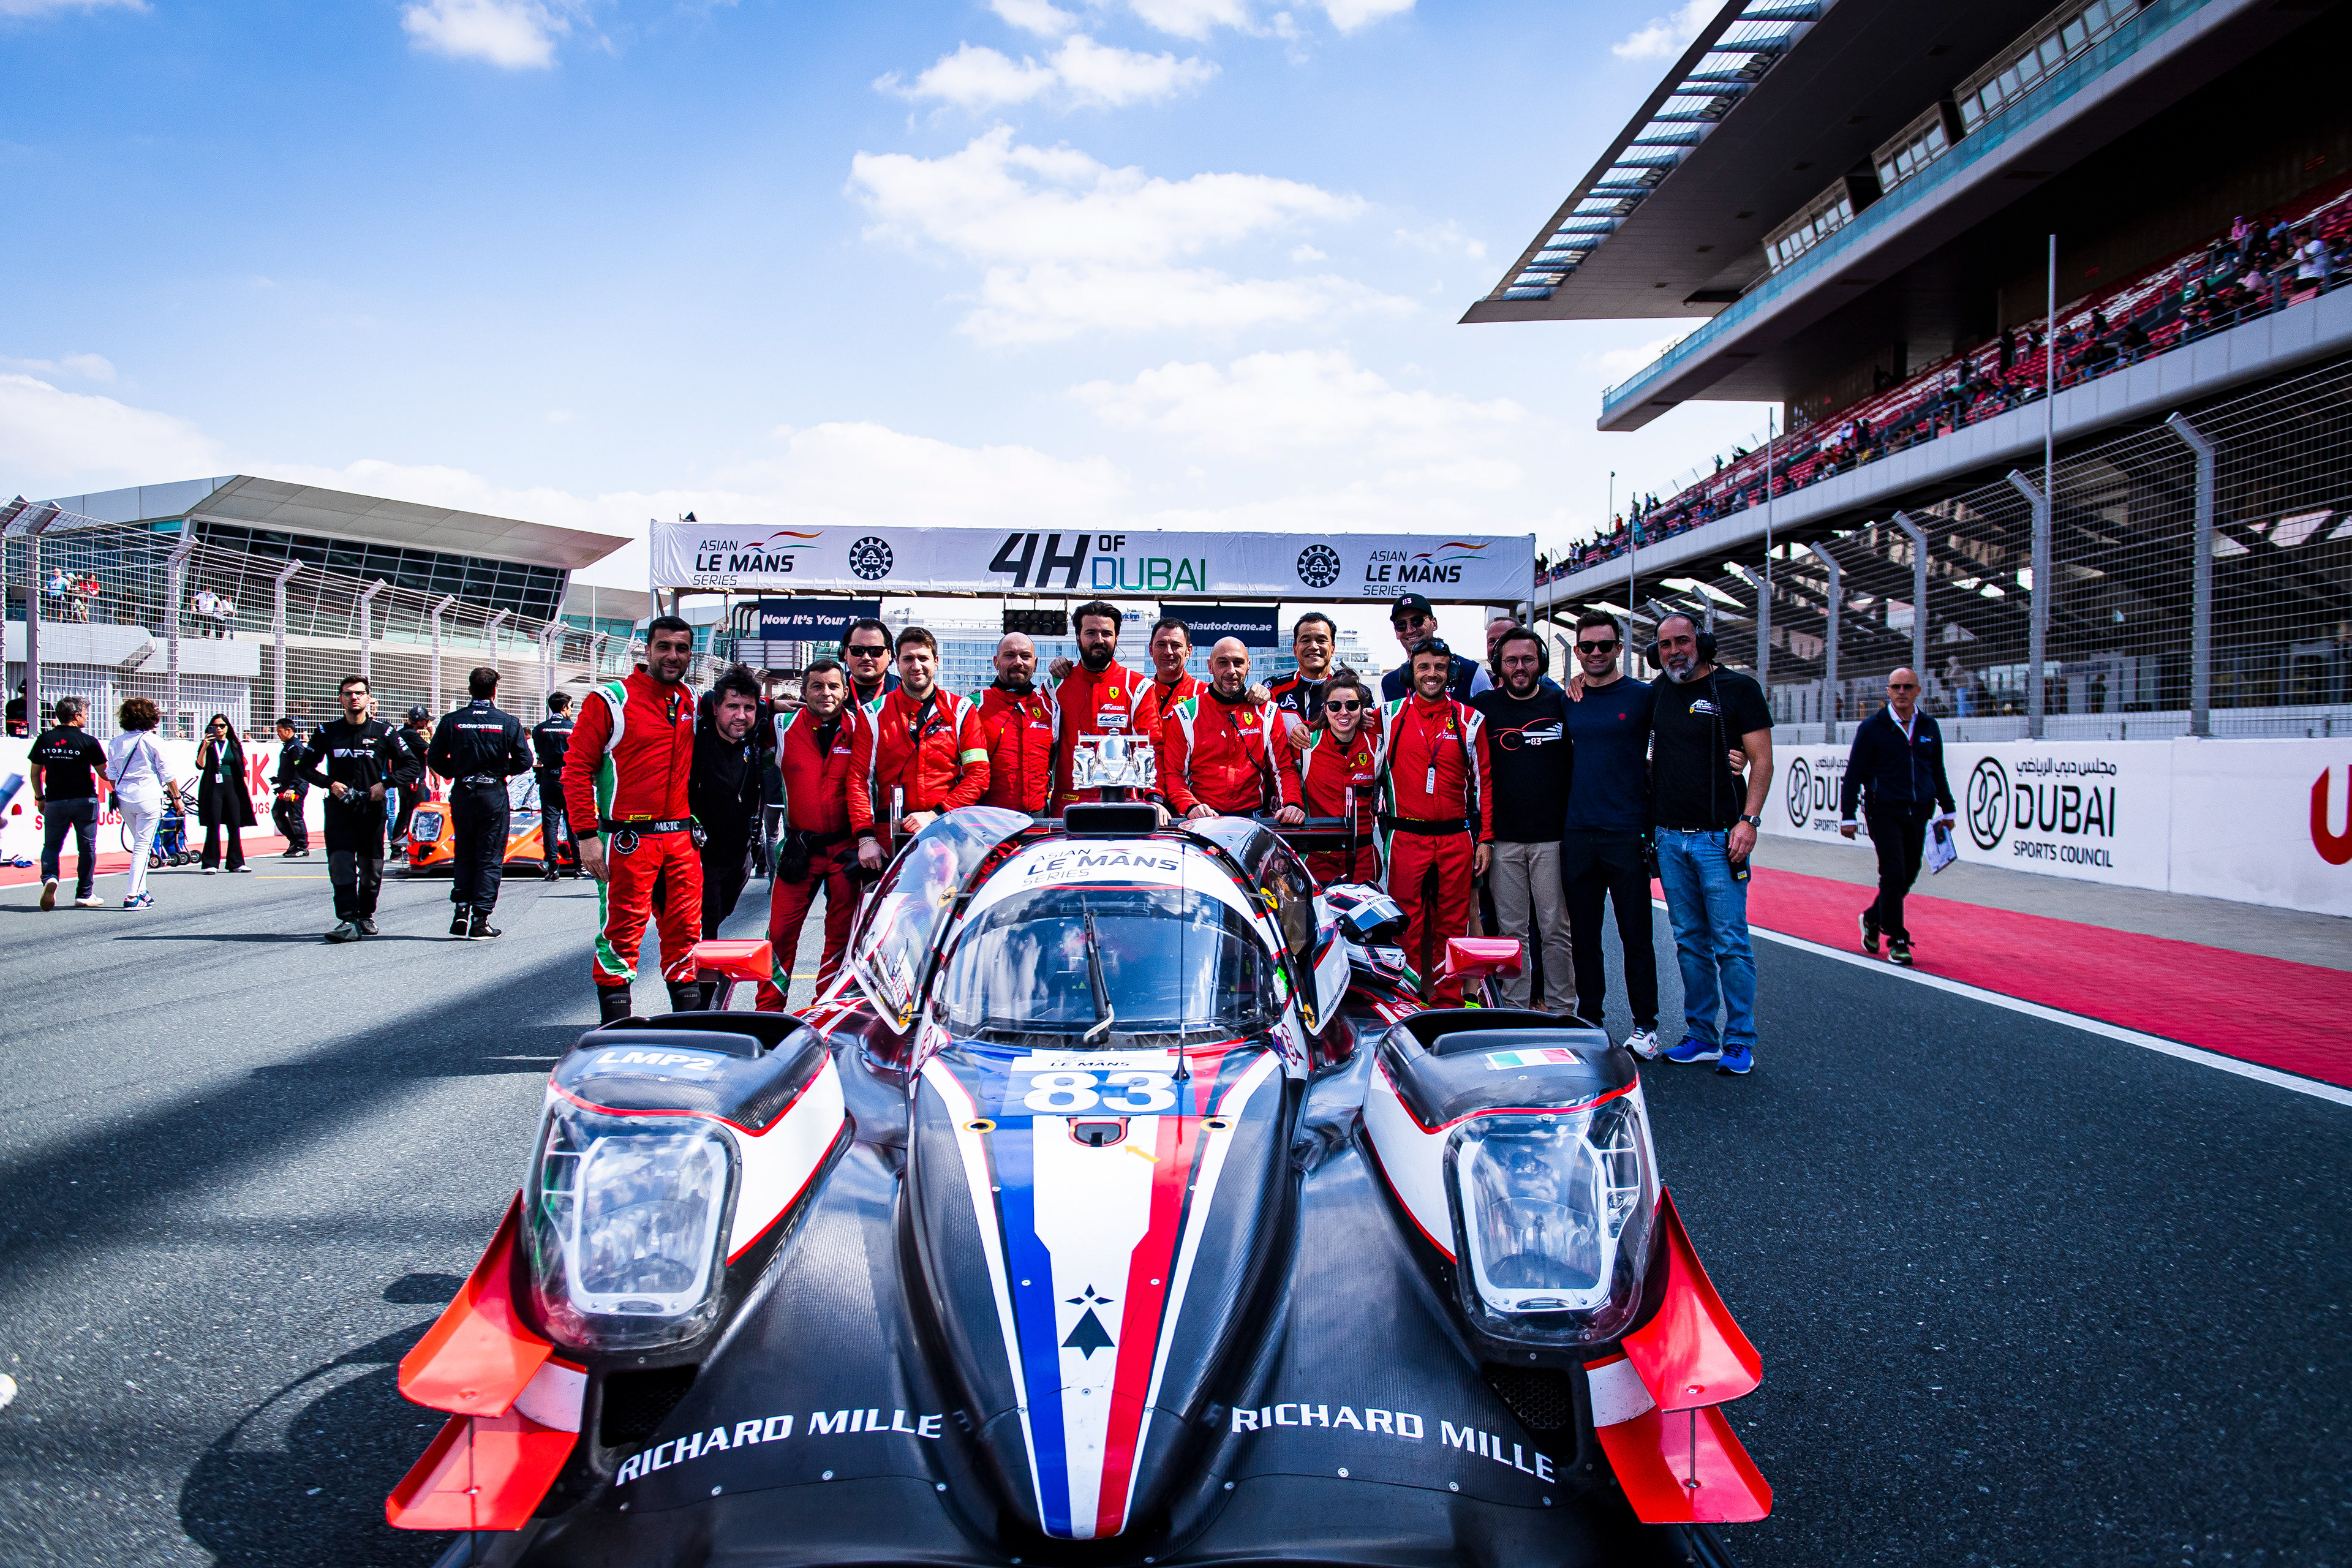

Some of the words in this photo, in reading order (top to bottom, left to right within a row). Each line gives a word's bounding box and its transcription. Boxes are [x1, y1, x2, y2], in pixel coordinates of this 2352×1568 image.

[699, 540, 738, 551] ASIAN
[1098, 534, 1126, 552] OF
[695, 554, 722, 571] LE
[729, 554, 794, 572] MANS
[989, 532, 1091, 589] 4H
[1369, 551, 1407, 561] ASIAN
[693, 575, 738, 586] SERIES
[1091, 556, 1205, 592] DUBAI
[1365, 564, 1392, 582] LE
[1398, 565, 1461, 582] MANS
[1363, 585, 1406, 595] SERIES
[762, 614, 791, 625] Now
[793, 614, 813, 625] It's
[816, 615, 846, 625] Your
[1183, 621, 1272, 631] baiautodrome.ae
[1136, 681, 1148, 695] Sabelt
[603, 690, 617, 704] Sabelt
[1178, 707, 1188, 720] Sabelt
[1472, 714, 1481, 727] Sabelt
[1531, 737, 1542, 746] 83
[342, 748, 375, 759] APR
[2015, 757, 2052, 777] الرياضي
[2054, 761, 2077, 778] دبي
[2078, 757, 2117, 779] مجلس
[429, 791, 447, 802] SPARK
[97, 810, 123, 826] UGS
[2015, 783, 2116, 838] DUBAI
[1814, 818, 1838, 832] SPORTS
[1033, 849, 1091, 863] ASIAN
[2014, 840, 2057, 860] SPORTS
[2060, 845, 2114, 867] COUNCIL
[1027, 858, 1066, 875] LE
[1077, 856, 1178, 870] MANS
[1022, 869, 1090, 886] SERIES
[595, 1051, 715, 1072] LMP2
[1023, 1071, 1176, 1113] 83
[615, 1414, 794, 1487] RICHARD
[808, 1408, 943, 1439] MILLE
[1232, 1403, 1424, 1439] RICHARD
[1441, 1420, 1555, 1484] MILLE
